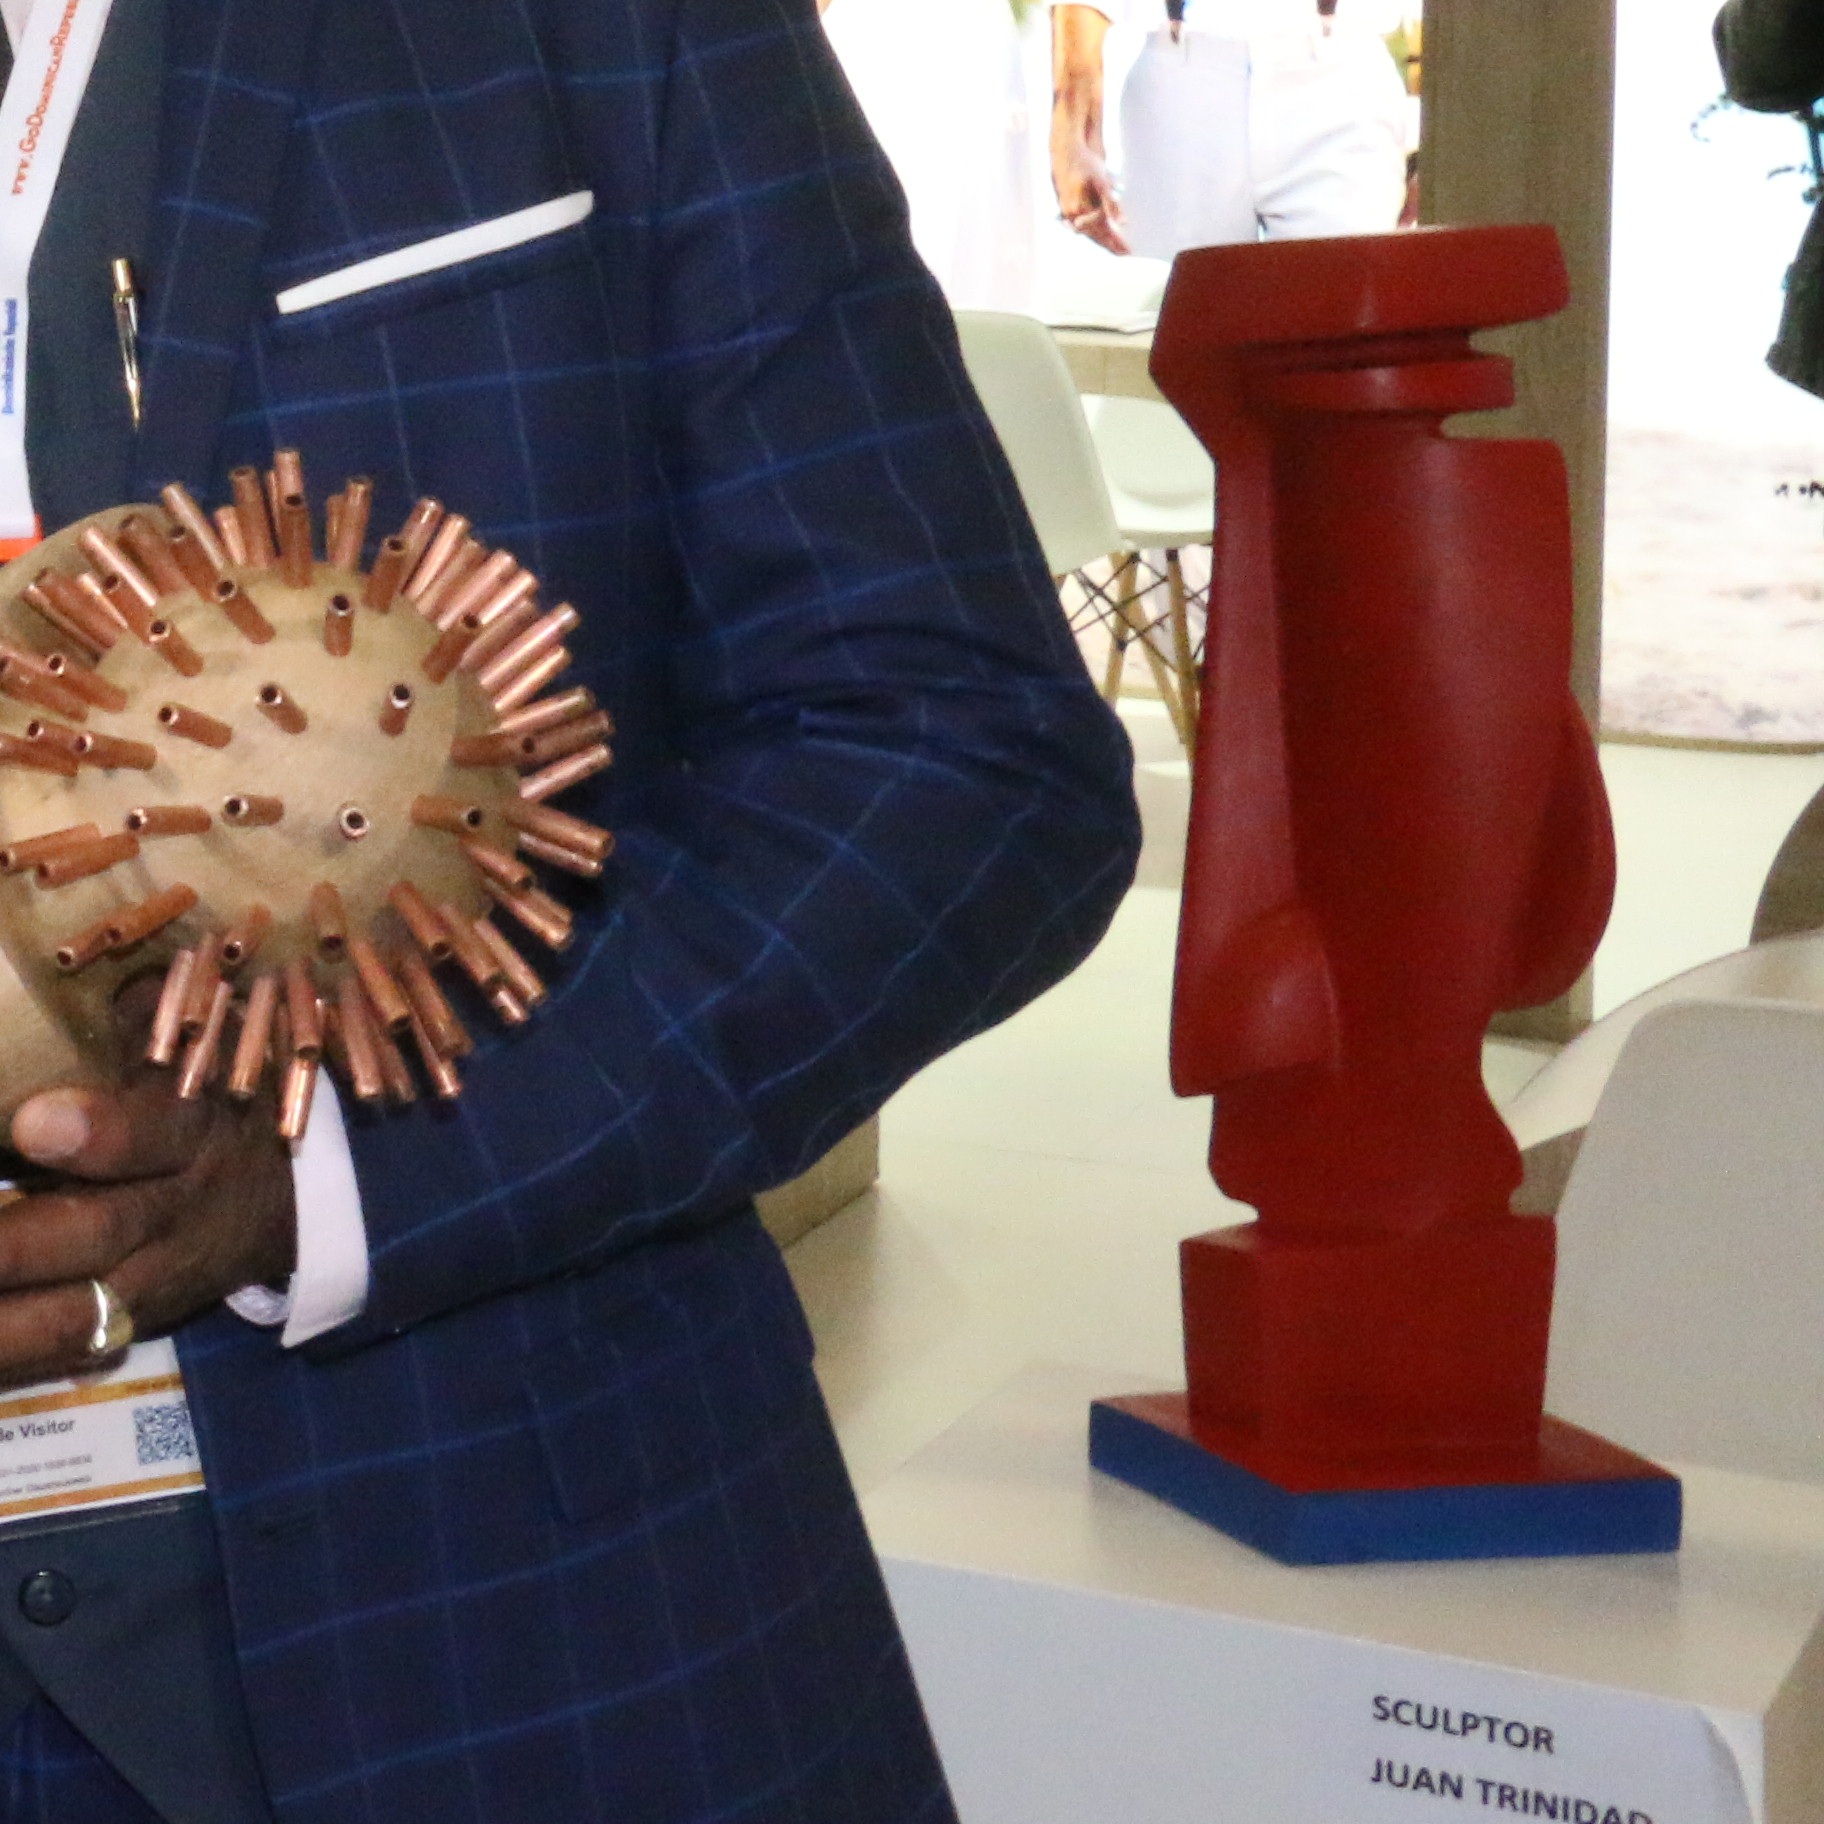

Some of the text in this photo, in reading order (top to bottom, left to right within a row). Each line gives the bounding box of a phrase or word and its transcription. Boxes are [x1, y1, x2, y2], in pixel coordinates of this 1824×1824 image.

[19, 1419, 75, 1439] Visitor
[1371, 1694, 1556, 1755] SCULPTOR
[1369, 1758, 1465, 1800] JUAN
